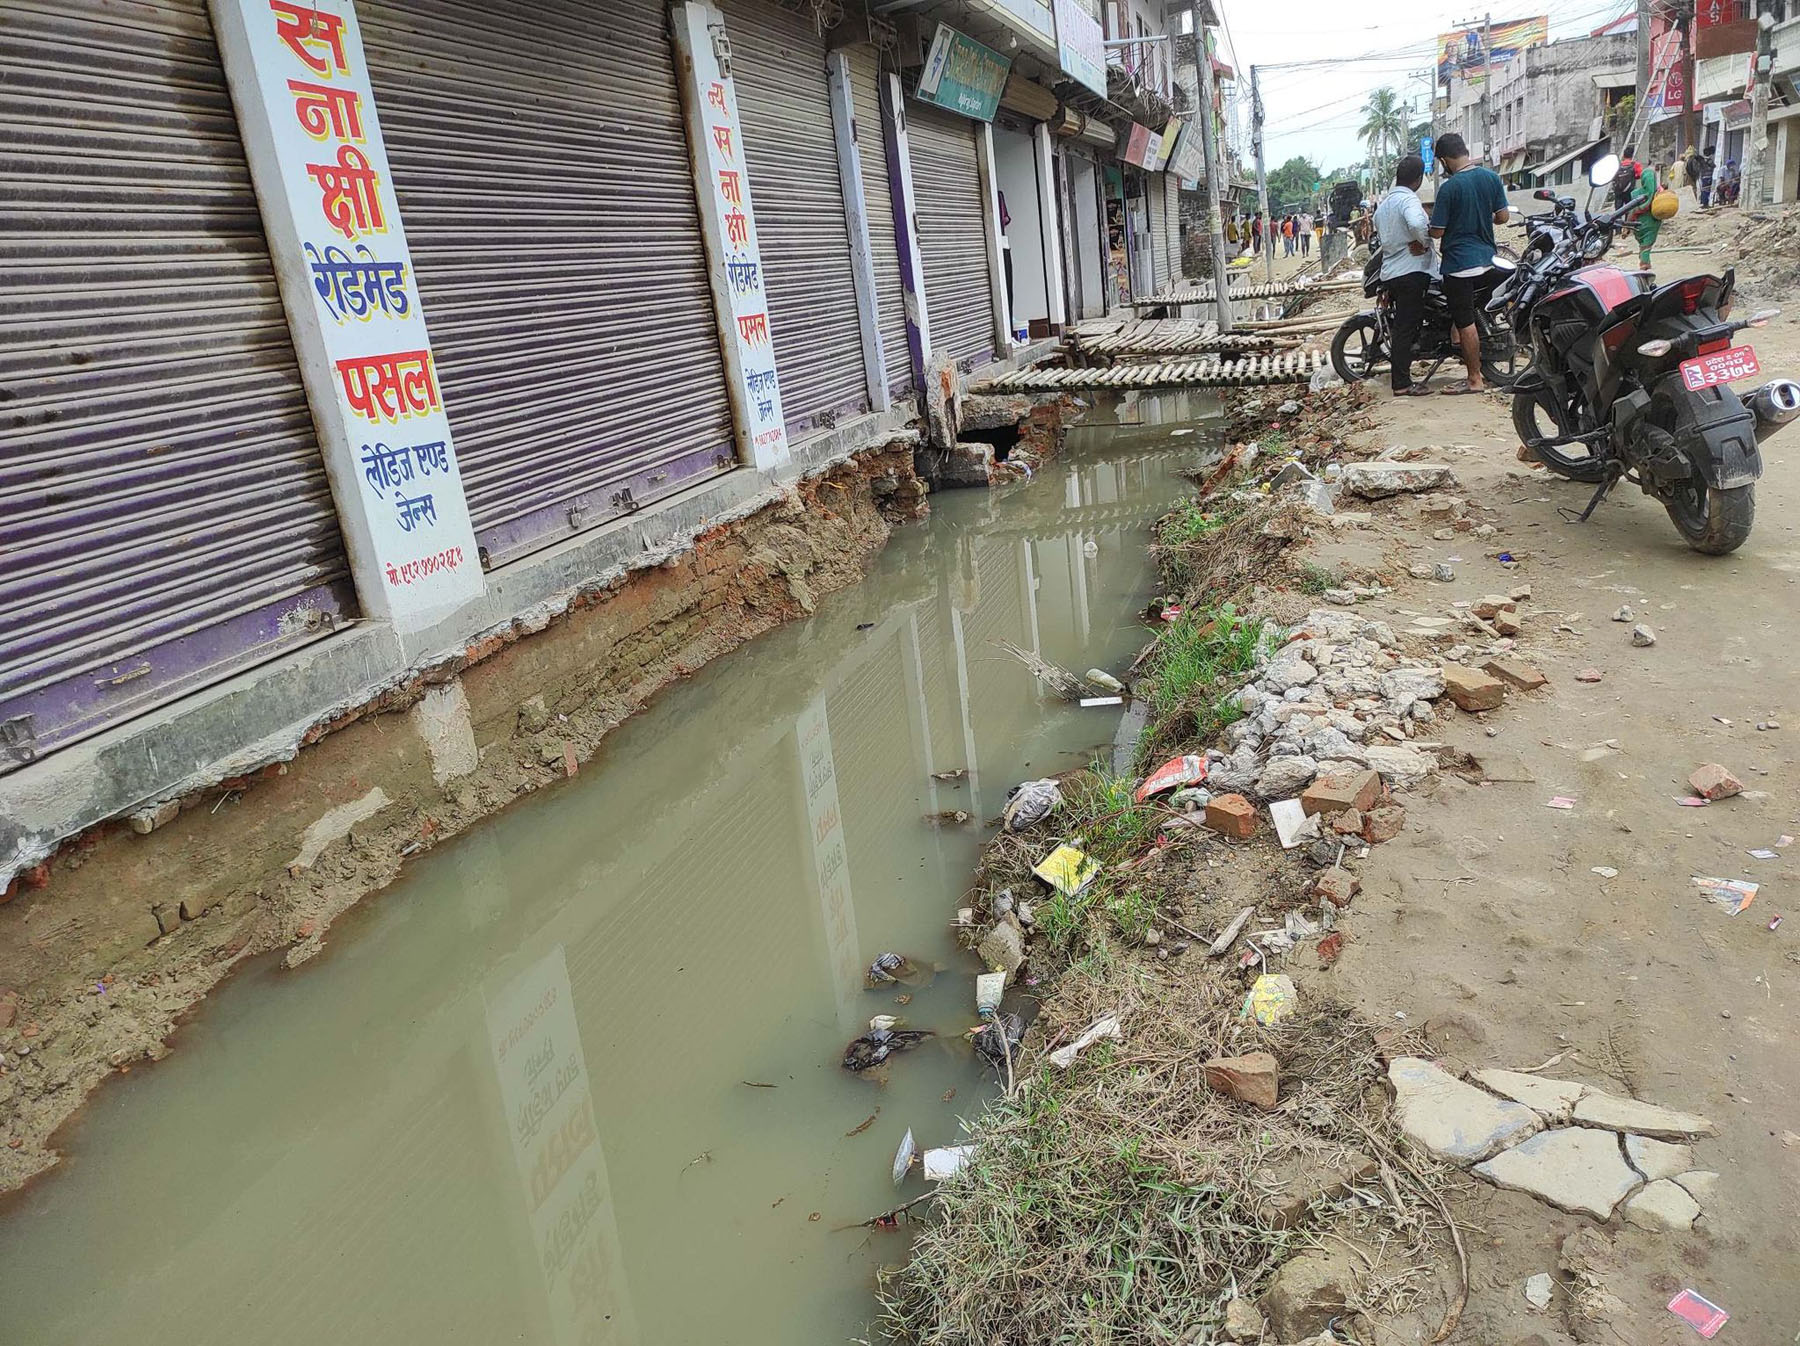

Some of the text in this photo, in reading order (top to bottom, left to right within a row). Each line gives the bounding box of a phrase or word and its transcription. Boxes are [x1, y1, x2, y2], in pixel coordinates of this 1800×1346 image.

[1668, 90, 1682, 100] LG
[304, 242, 409, 321] रेडिमेड
[726, 252, 759, 300] रेडिमेड
[736, 314, 768, 350] पसल
[336, 350, 438, 420] पसल
[361, 442, 415, 500] लेडिज
[395, 491, 437, 532] जेन्स
